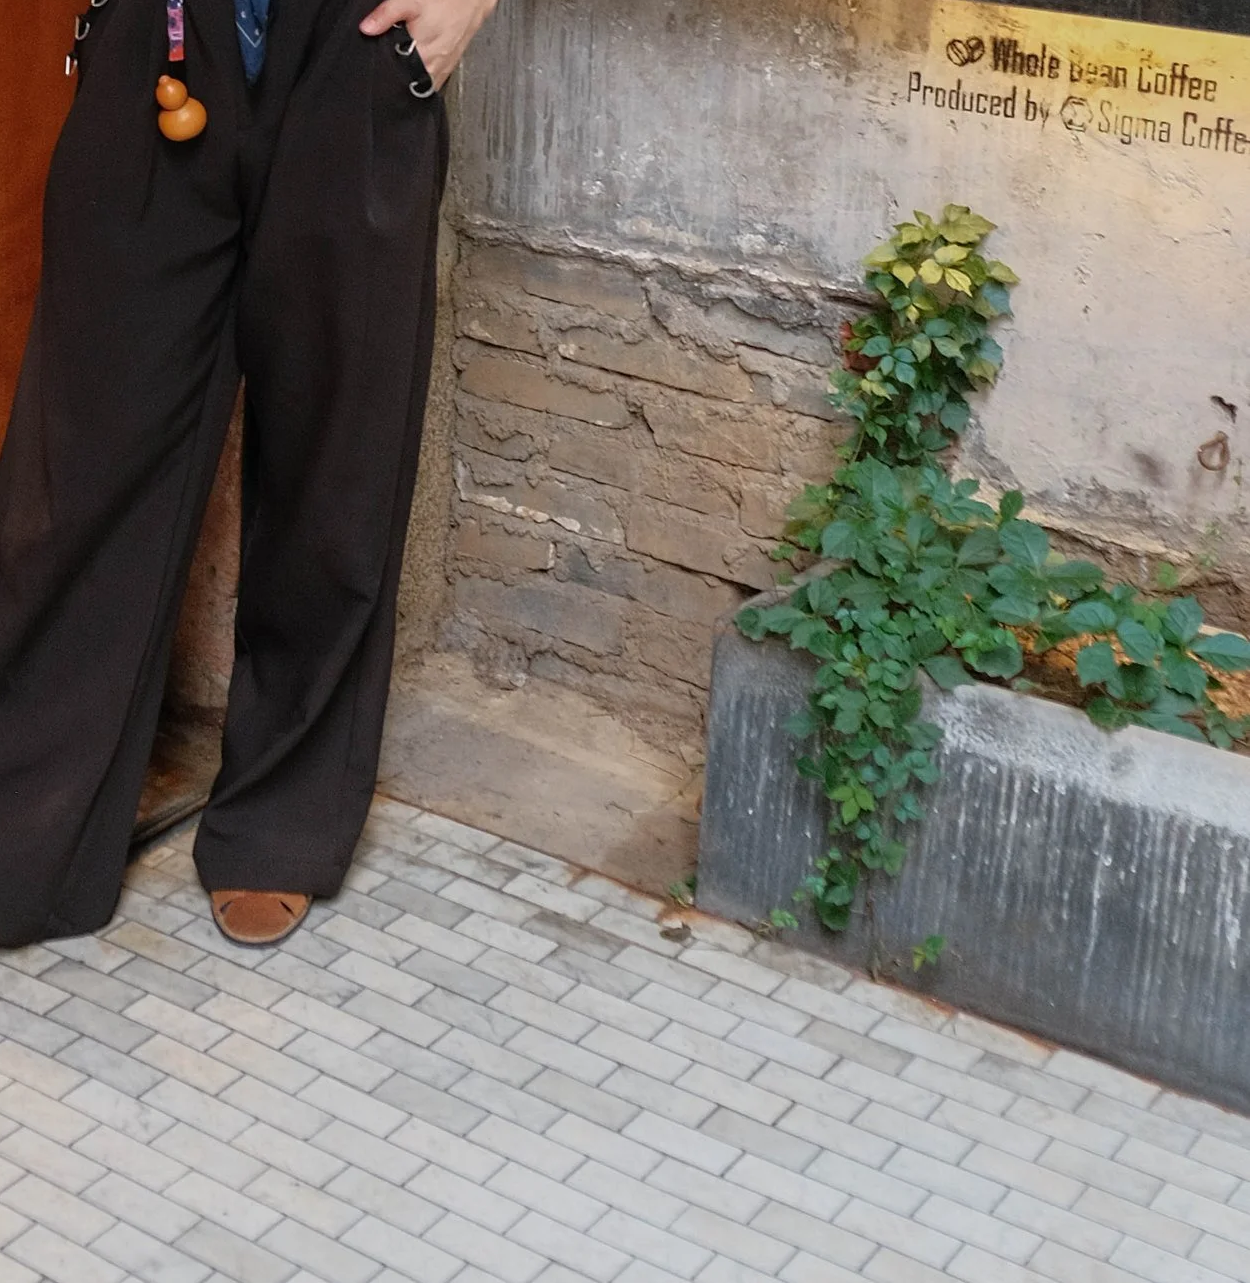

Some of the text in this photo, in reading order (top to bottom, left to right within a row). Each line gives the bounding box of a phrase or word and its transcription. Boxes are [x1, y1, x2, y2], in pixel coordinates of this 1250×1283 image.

[990, 34, 1059, 80] Whole
[1137, 61, 1218, 102] Coffee
[907, 70, 1017, 119] Produced
[1025, 88, 1051, 133] by
[1098, 99, 1172, 145] Sigma
